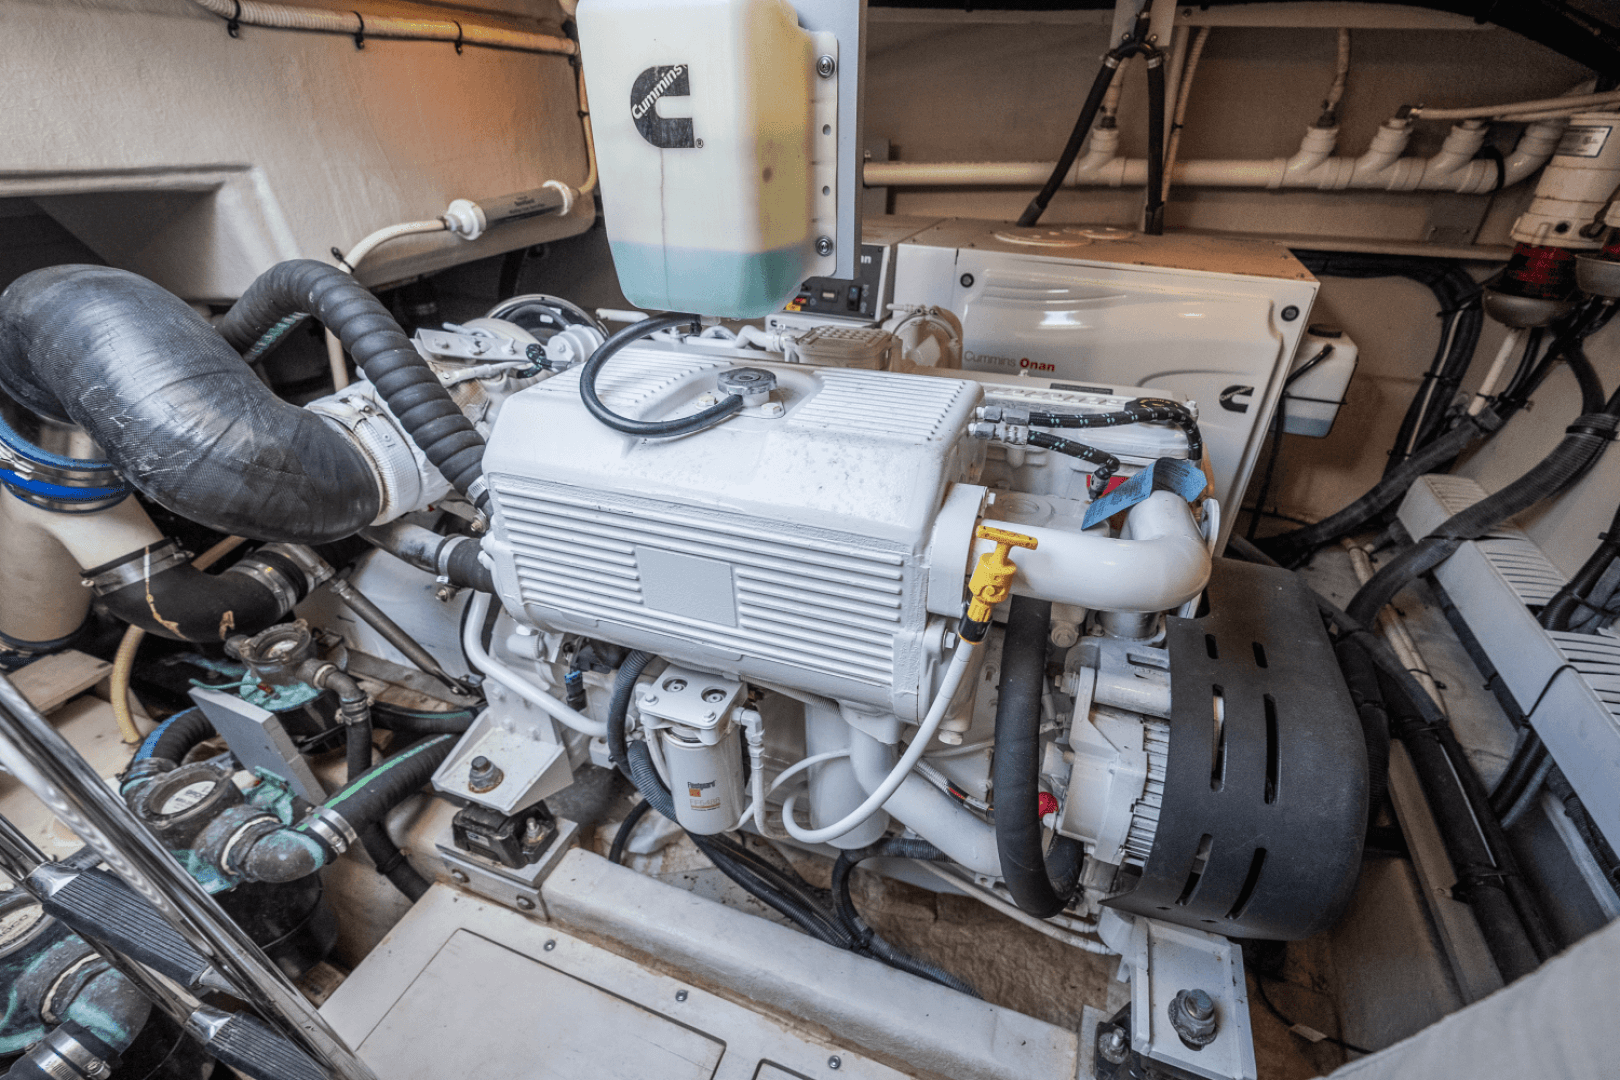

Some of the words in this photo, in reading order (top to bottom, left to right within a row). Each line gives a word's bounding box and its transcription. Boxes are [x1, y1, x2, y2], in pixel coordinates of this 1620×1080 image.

[632, 64, 683, 119] Cummins
[964, 350, 1016, 367] Cummins
[1020, 358, 1055, 372] Onan
